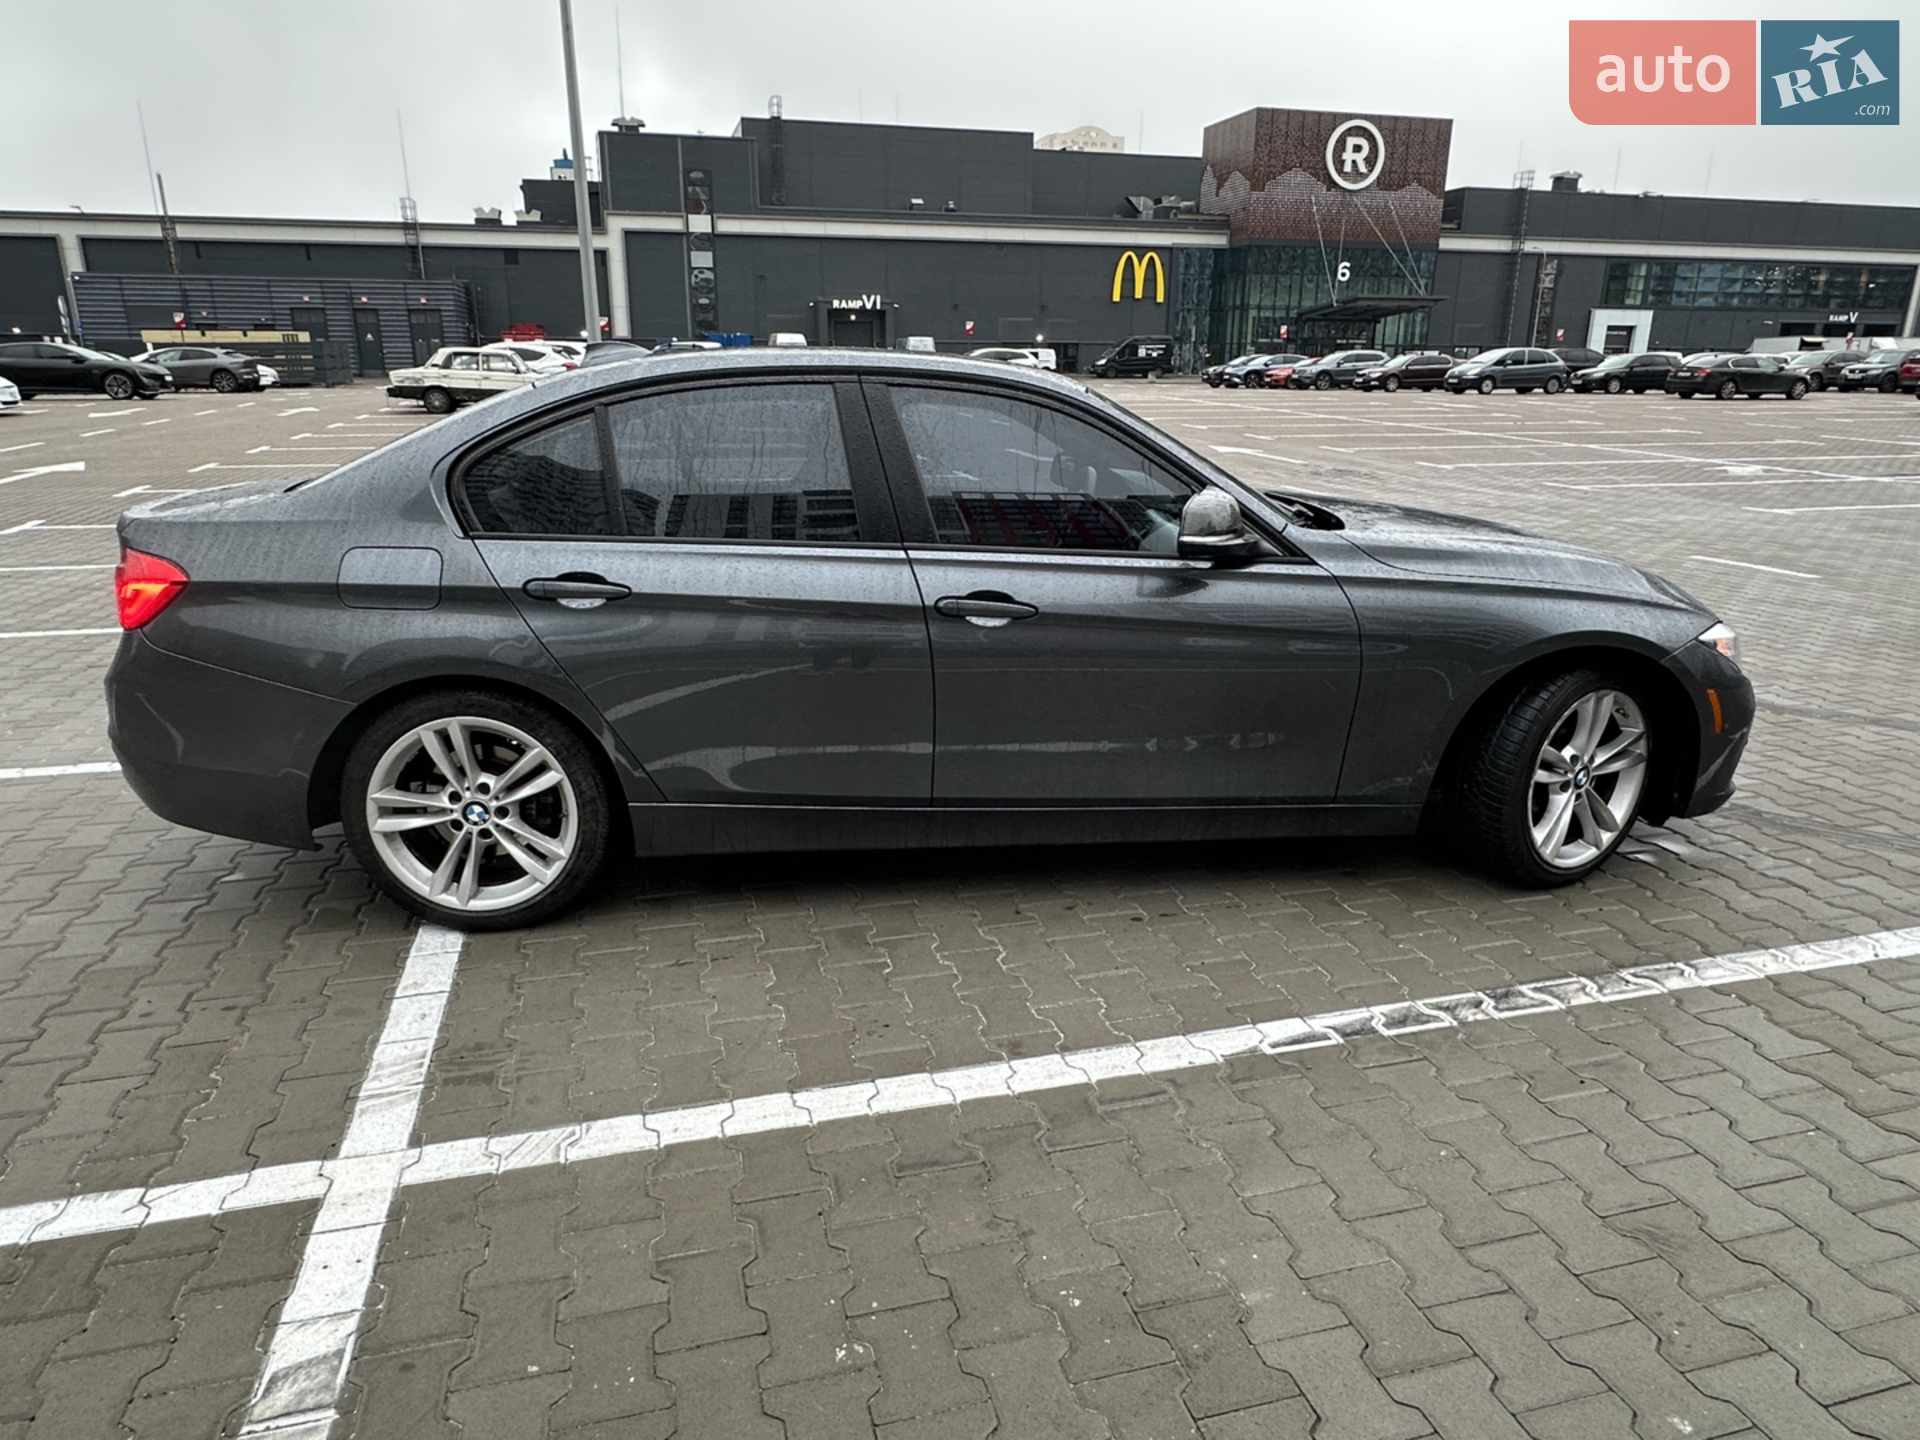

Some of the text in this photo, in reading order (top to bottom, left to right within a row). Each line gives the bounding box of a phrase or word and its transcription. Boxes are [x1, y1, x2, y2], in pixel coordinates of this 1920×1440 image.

[1337, 261, 1351, 282] 6
[832, 294, 881, 310] RAMP VI
